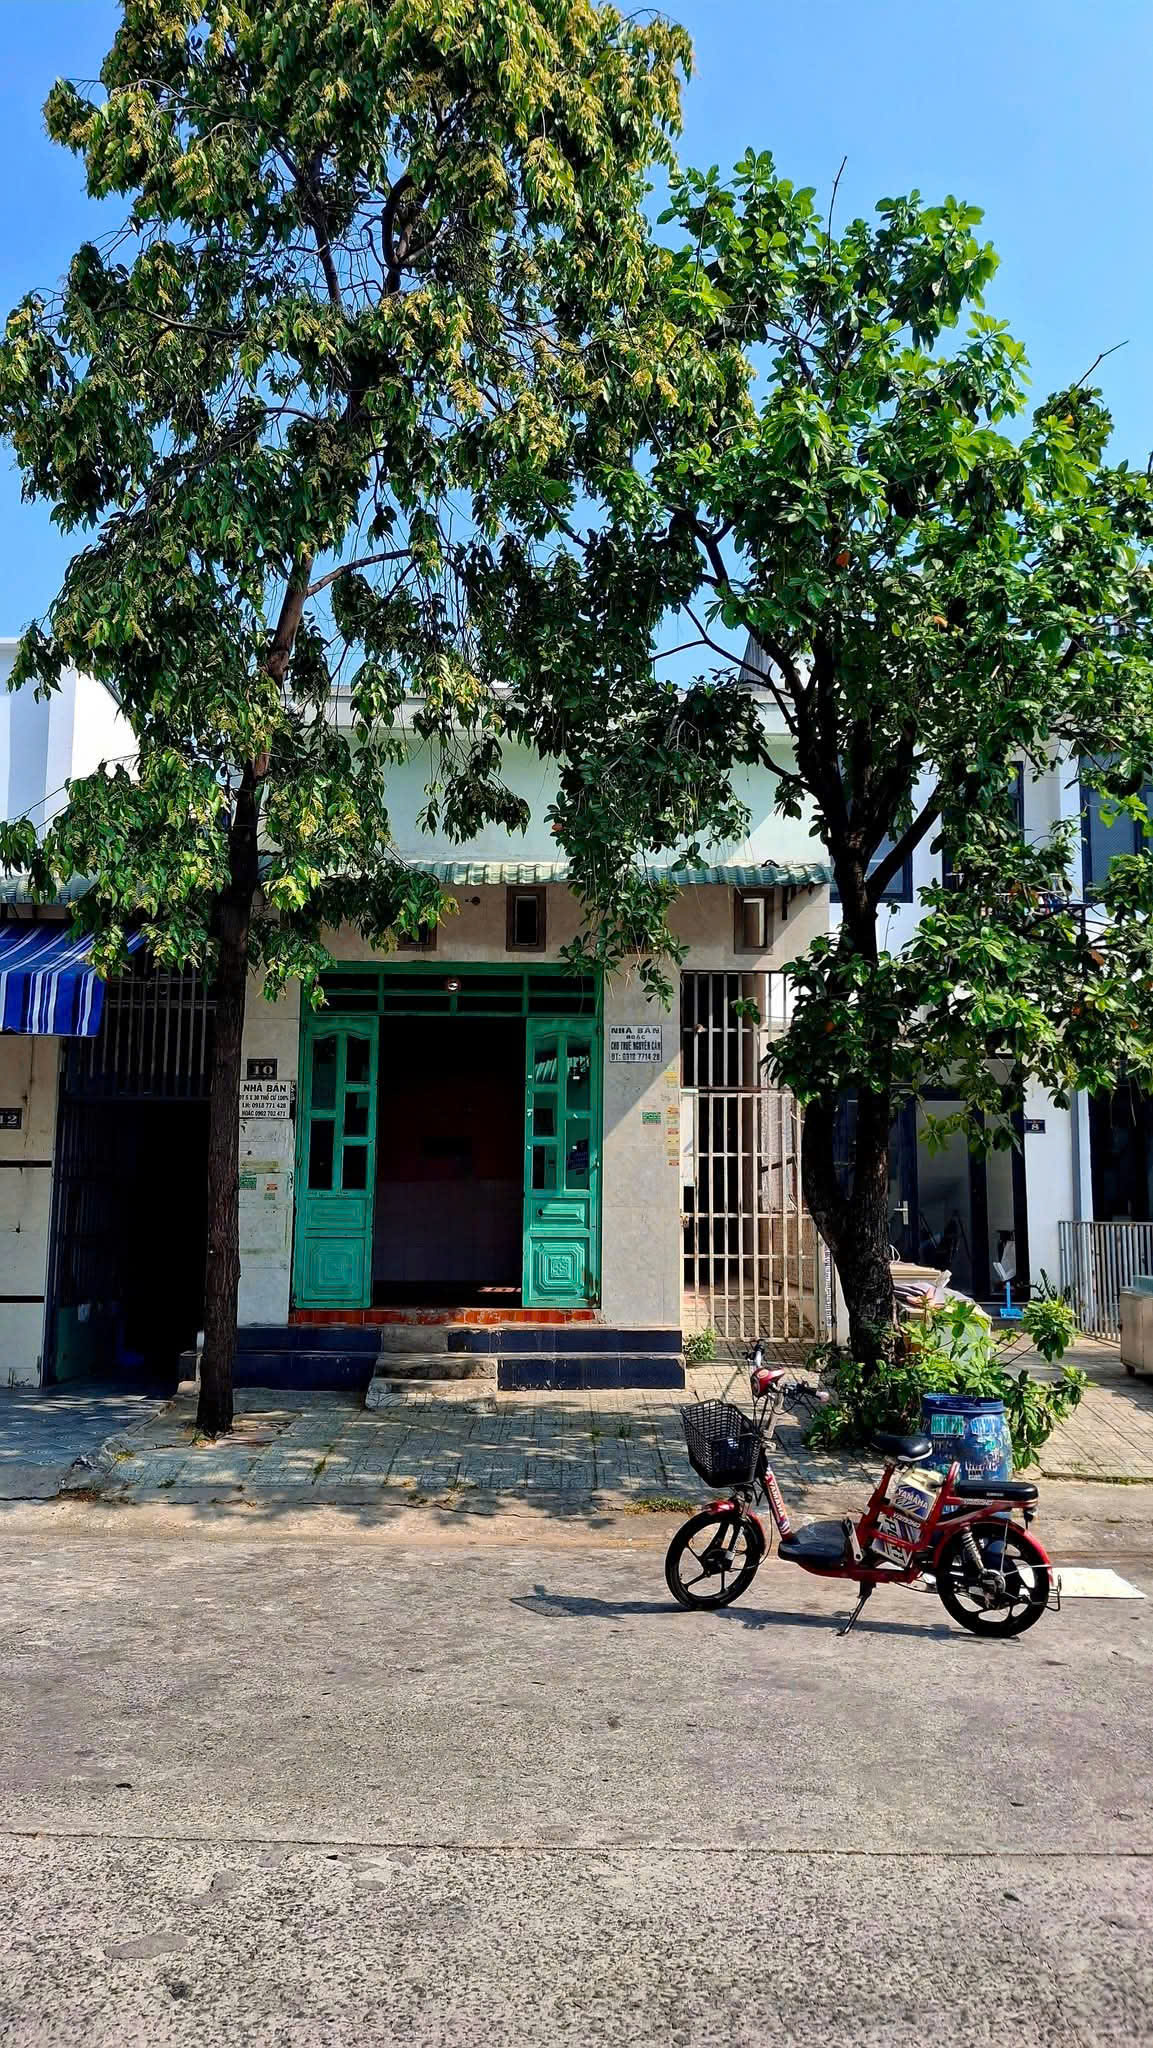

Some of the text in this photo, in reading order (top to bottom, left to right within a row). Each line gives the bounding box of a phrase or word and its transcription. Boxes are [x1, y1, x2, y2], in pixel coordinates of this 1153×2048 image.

[254, 1066, 273, 1075] 10
[0, 1114, 17, 1124] 12
[1031, 1123, 1040, 1131] 8
[768, 1481, 785, 1518] YAMAHA
[897, 1487, 929, 1510] YAMAHA
